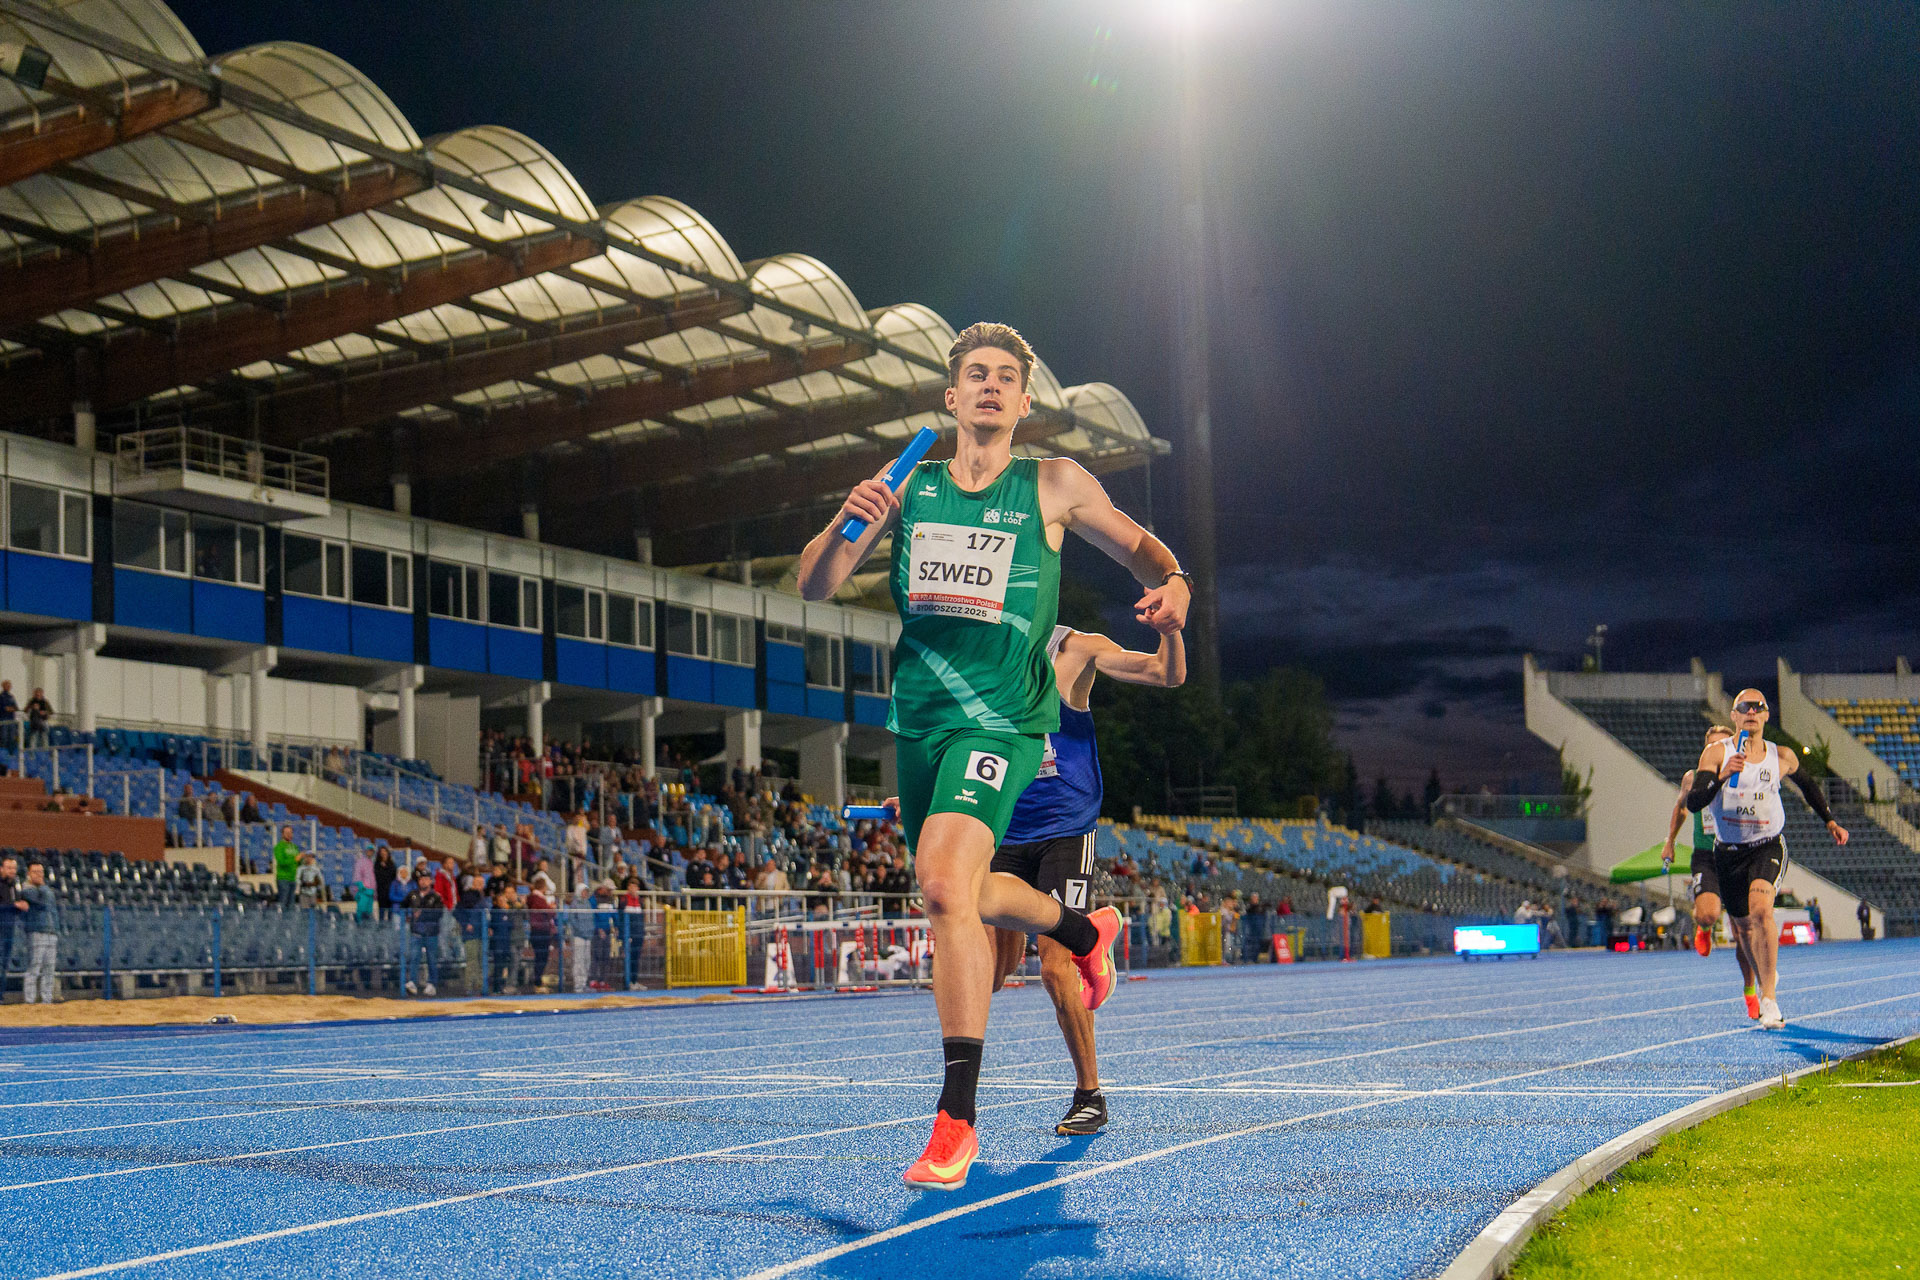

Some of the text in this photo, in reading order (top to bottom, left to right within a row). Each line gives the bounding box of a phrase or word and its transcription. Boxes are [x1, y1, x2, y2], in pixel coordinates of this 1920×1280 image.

[967, 532, 1006, 553] 177
[918, 561, 993, 587] SZWED
[933, 594, 975, 604] Mistrzostwa
[976, 599, 998, 609] Polski
[916, 604, 988, 617] BYDGOSZCZ 2025
[976, 756, 999, 781] 6
[954, 794, 979, 805] erima
[1753, 792, 1765, 801] 18
[1736, 805, 1756, 816] PAŚ
[1072, 882, 1085, 906] 7
